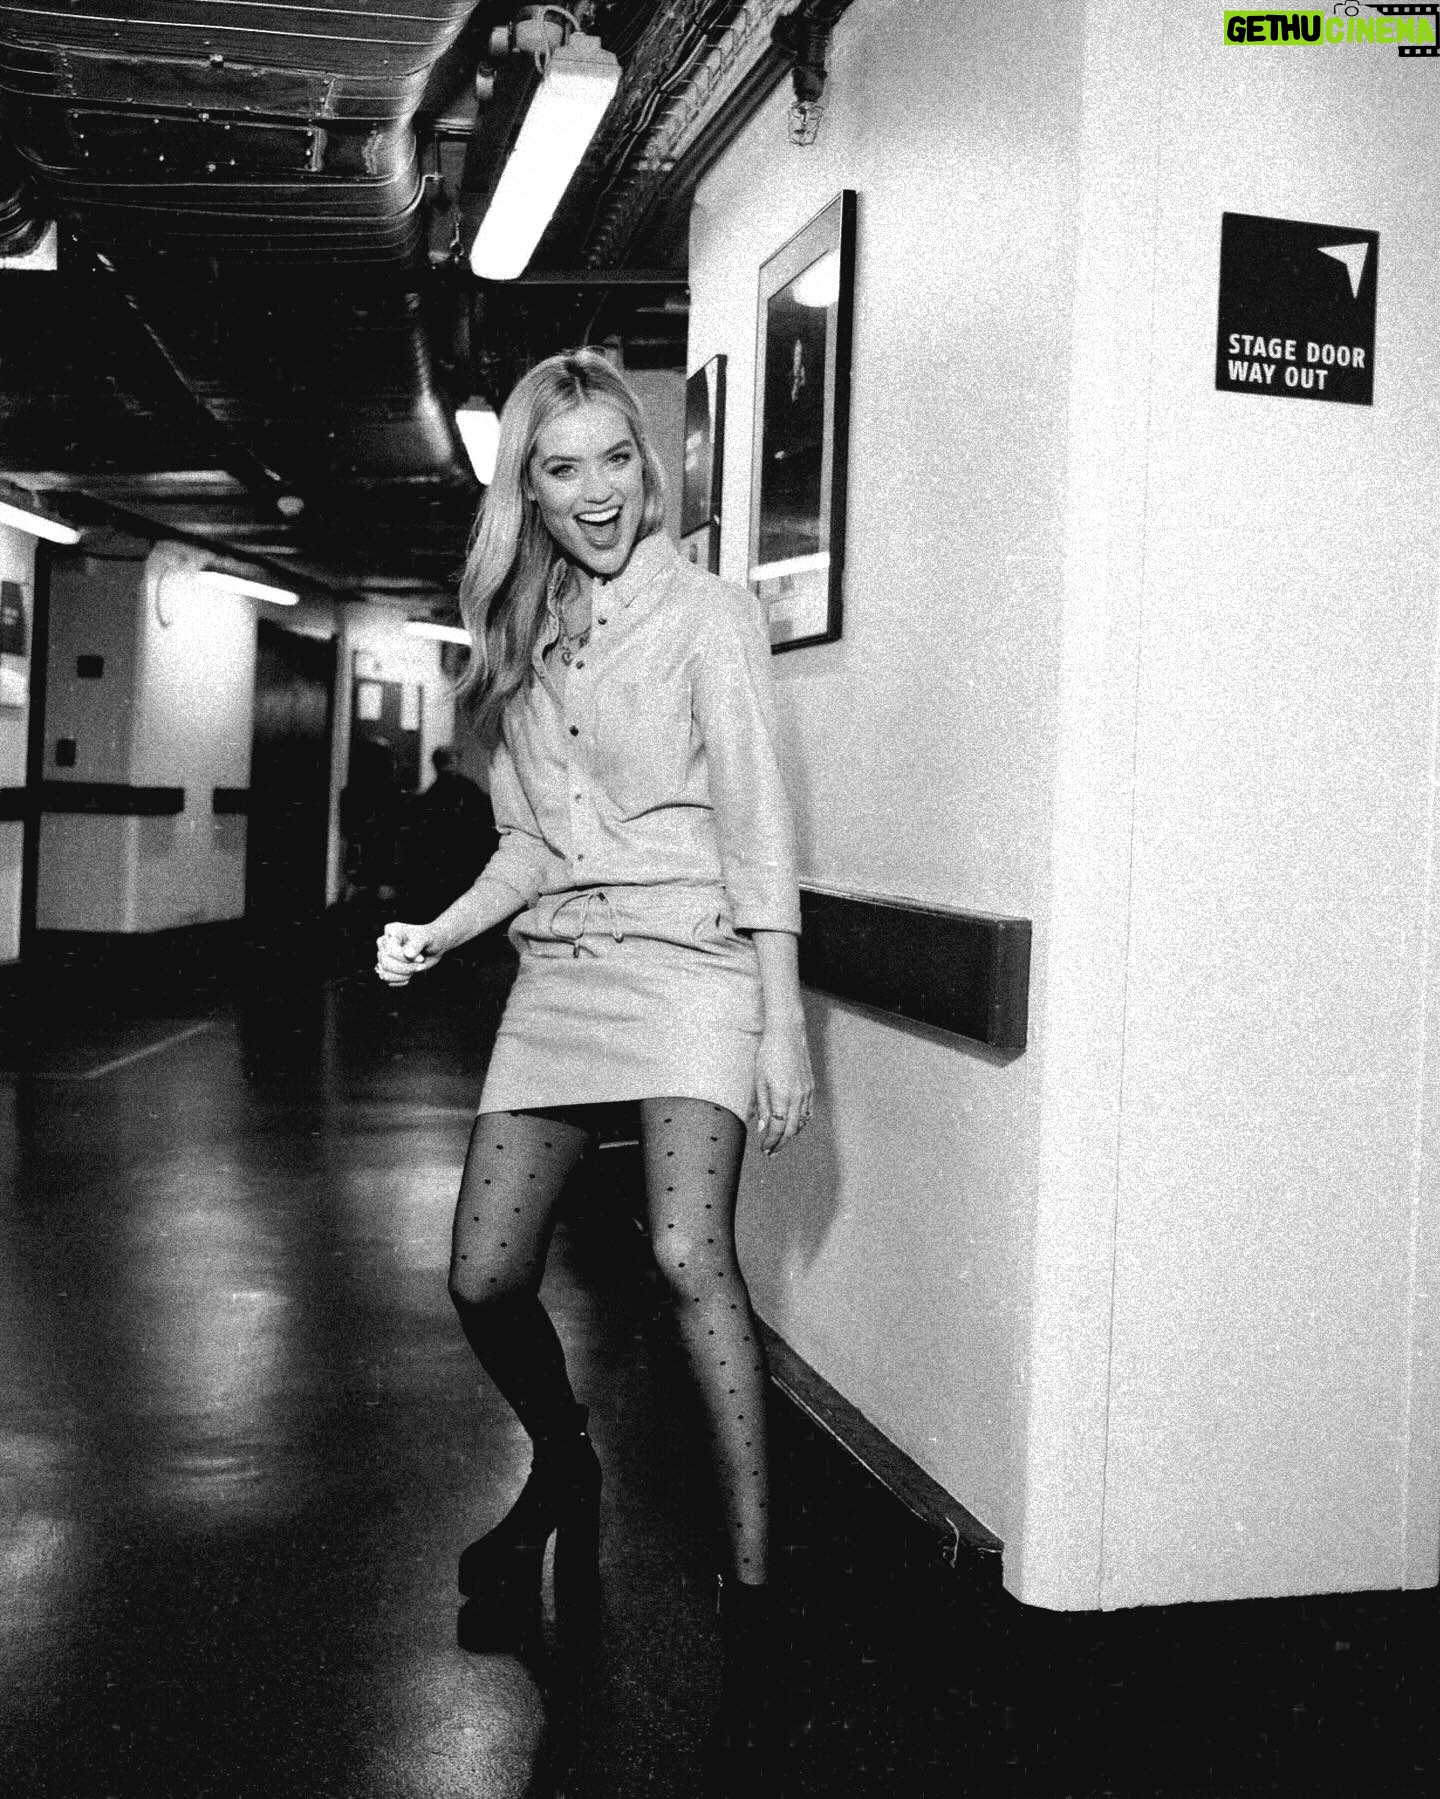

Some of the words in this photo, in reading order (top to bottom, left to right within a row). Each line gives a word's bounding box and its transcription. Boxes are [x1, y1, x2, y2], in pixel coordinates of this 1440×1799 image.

[1228, 333, 1297, 361] STAGE
[1306, 341, 1366, 369] DOOR
[1227, 359, 1276, 385] WAY
[1284, 366, 1329, 390] OUT
